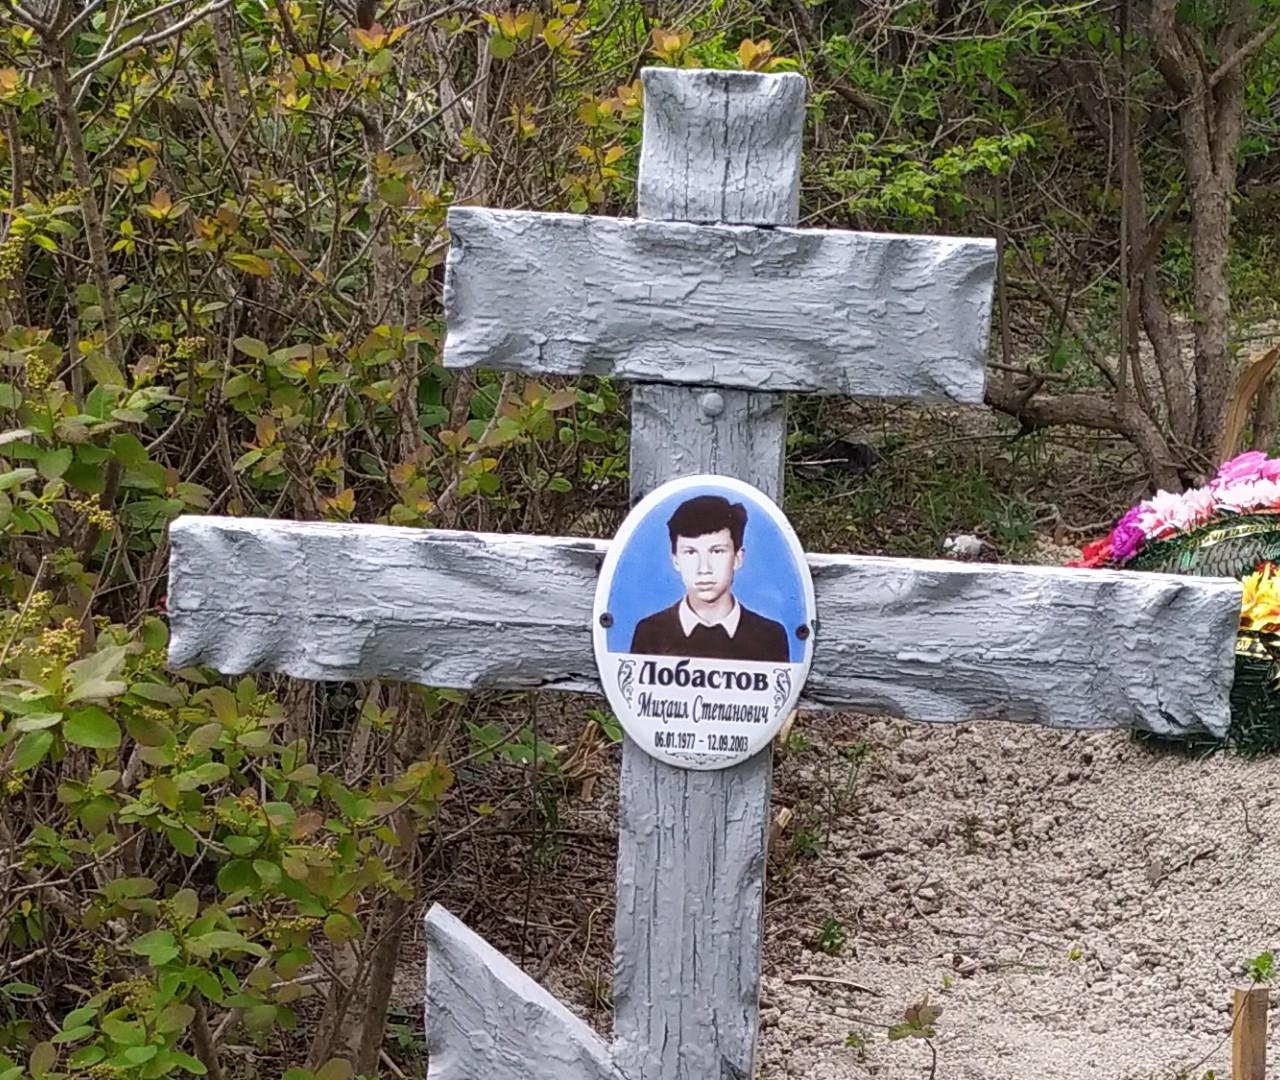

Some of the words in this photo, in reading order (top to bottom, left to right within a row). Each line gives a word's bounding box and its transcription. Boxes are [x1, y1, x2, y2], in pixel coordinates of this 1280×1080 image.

[638, 659, 769, 691] Лобастов
[637, 692, 689, 724] Михаил
[692, 695, 769, 723] Степанович
[654, 731, 696, 750] 06.01.1977
[707, 733, 749, 752] 12.09.2003
